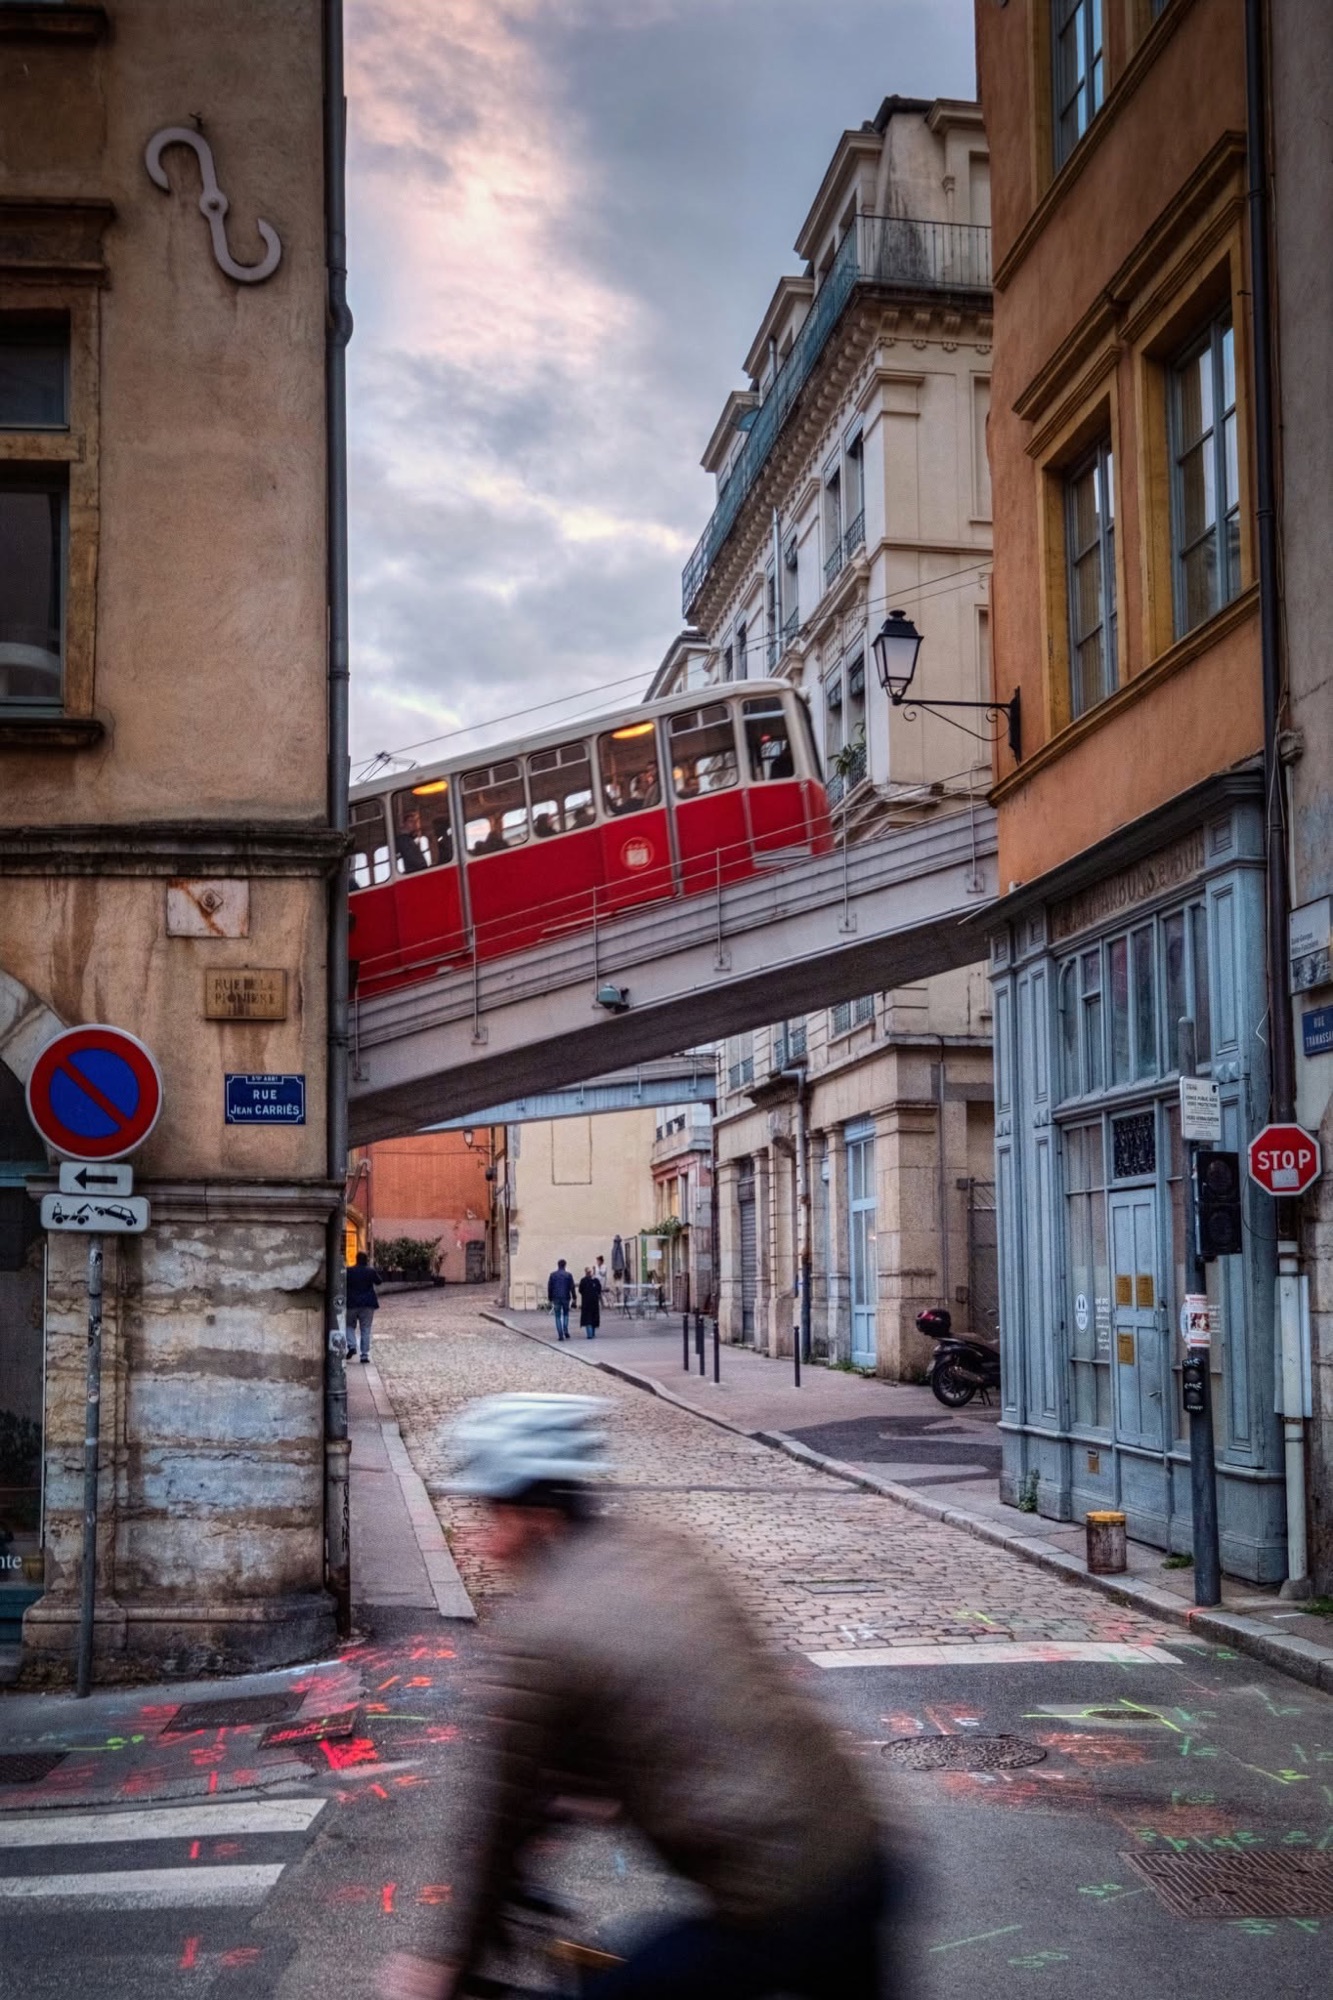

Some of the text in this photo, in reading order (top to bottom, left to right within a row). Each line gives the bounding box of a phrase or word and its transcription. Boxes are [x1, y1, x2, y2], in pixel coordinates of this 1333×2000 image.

[1313, 1015, 1325, 1029] RUE
[253, 1089, 277, 1100] RUE
[1257, 1148, 1311, 1170] STOP
